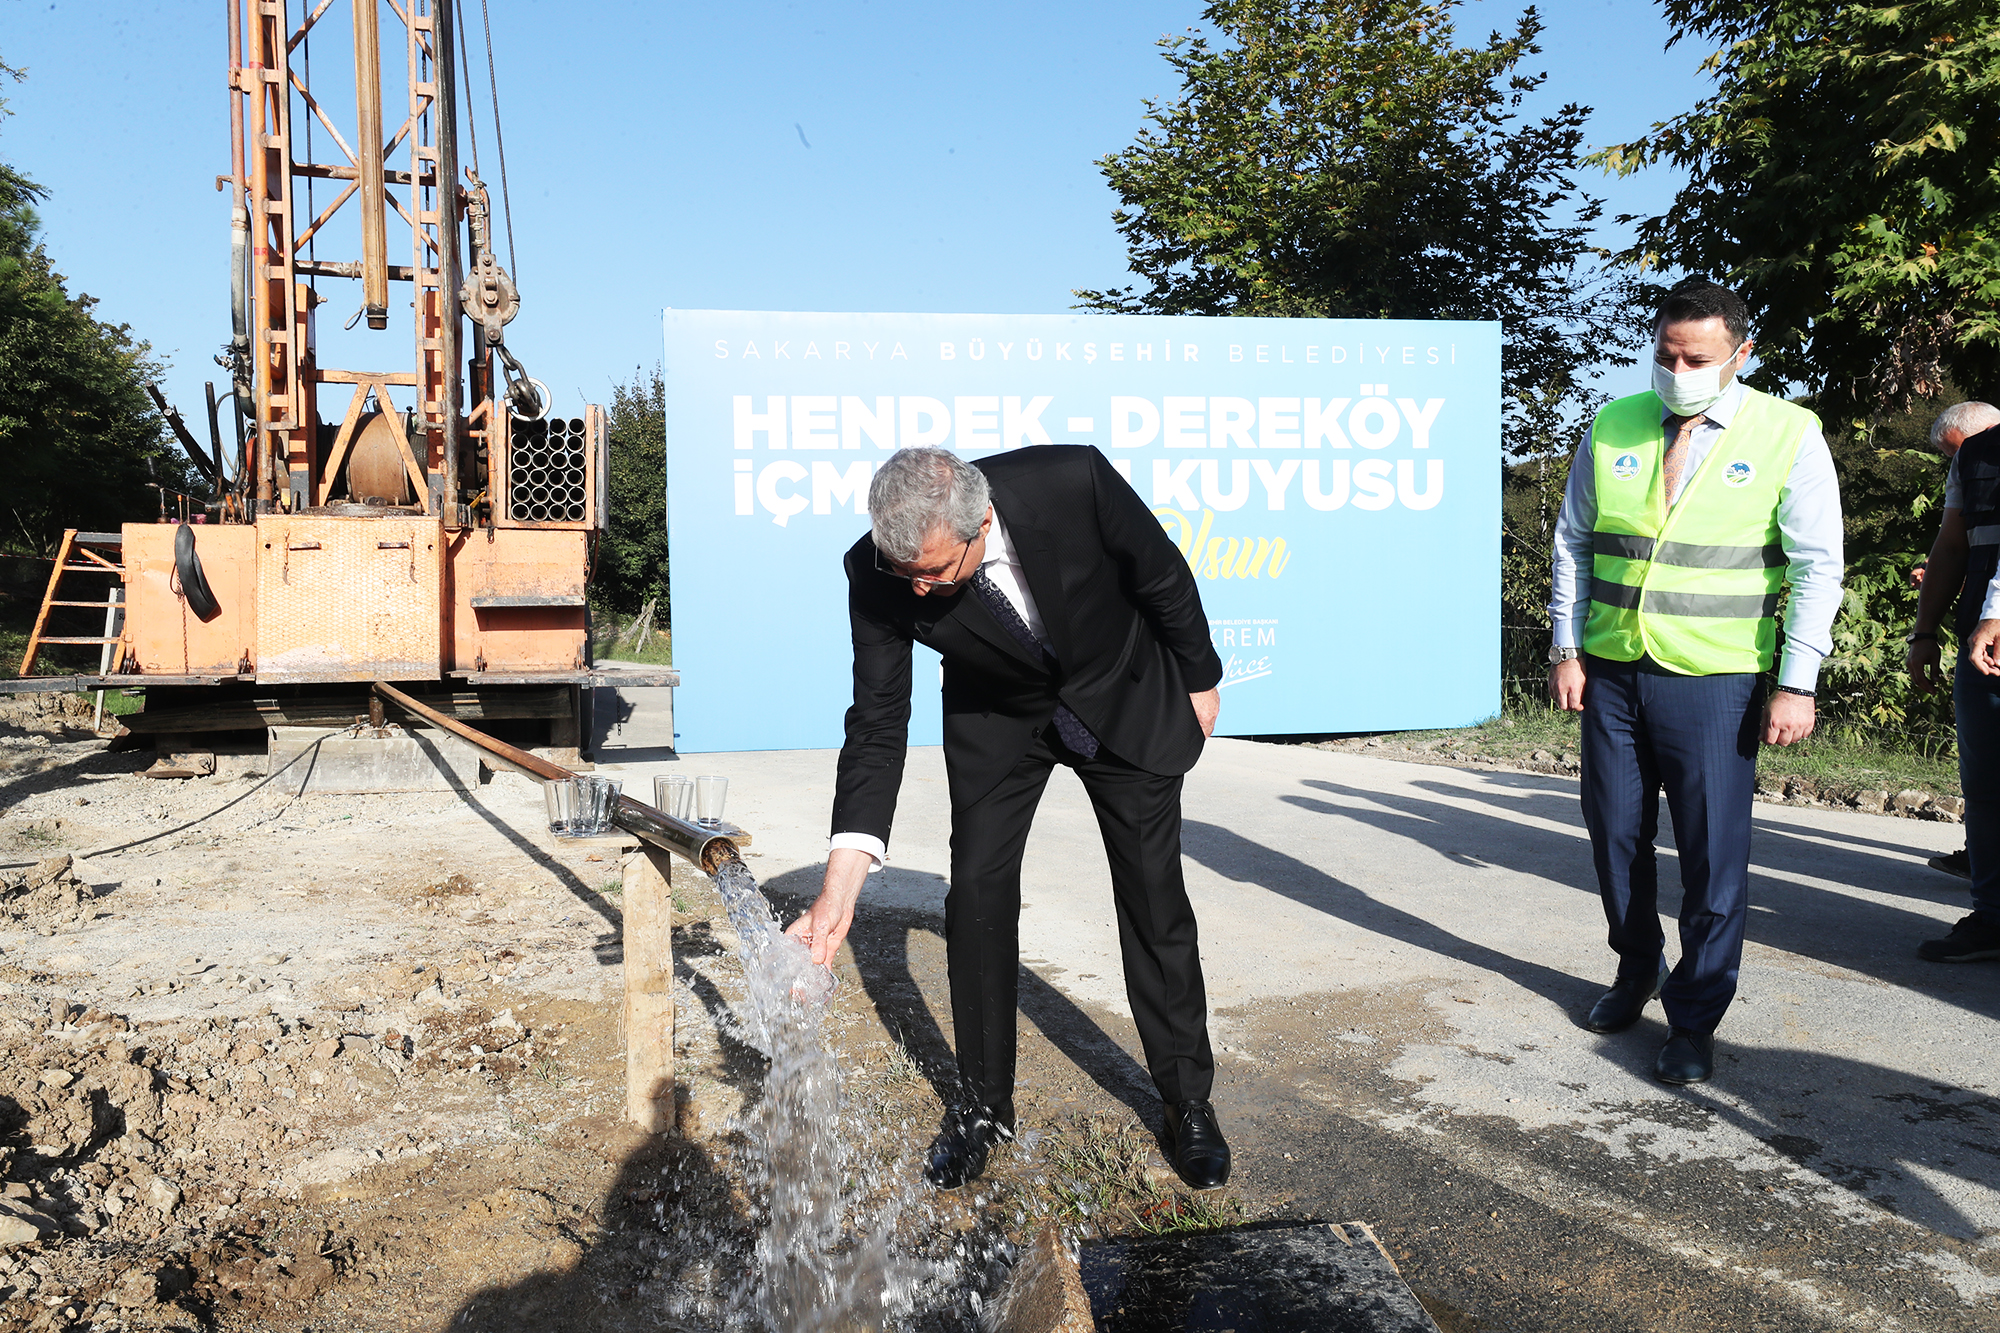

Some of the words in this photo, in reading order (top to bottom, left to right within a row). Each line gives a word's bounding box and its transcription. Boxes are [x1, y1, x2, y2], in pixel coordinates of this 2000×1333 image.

[714, 339, 909, 360] SAKARYA
[940, 337, 1200, 365] BÜYÜKŞEHİR
[1229, 342, 1457, 366] BELEDİYESİ
[733, 395, 1055, 450] HENDEK
[1110, 383, 1446, 450] DEREKÖY
[733, 458, 886, 528] İÇM
[1150, 458, 1445, 512] KUYUSU
[1209, 627, 1276, 647] KREM
[1223, 618, 1251, 626] BELEDİYE
[1253, 618, 1279, 627] BAŞKANI
